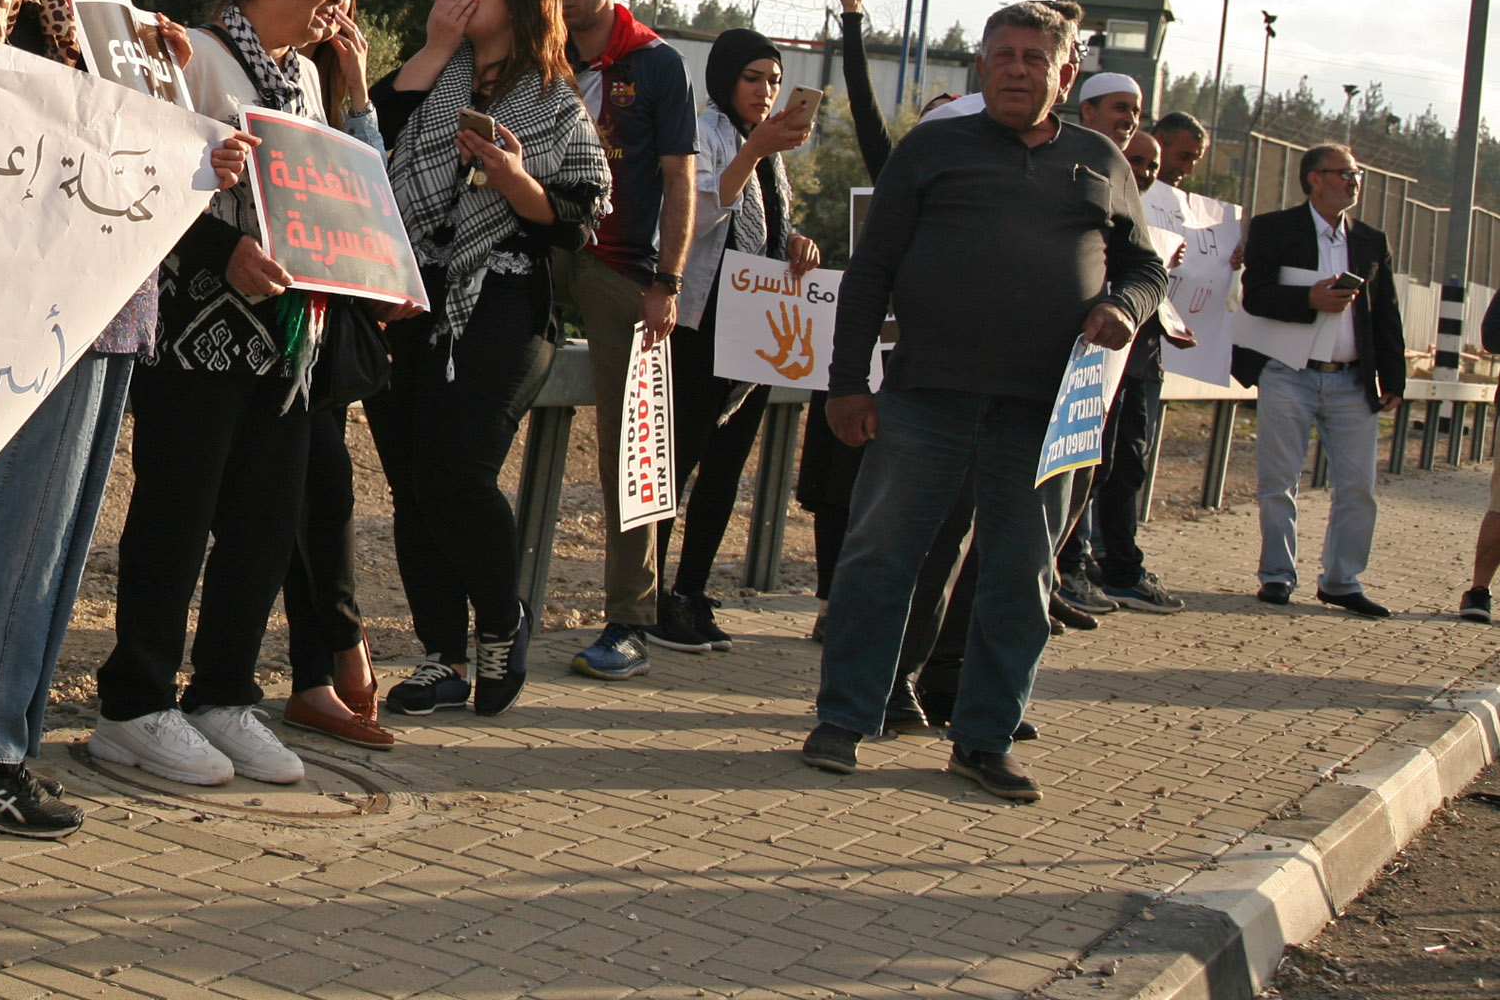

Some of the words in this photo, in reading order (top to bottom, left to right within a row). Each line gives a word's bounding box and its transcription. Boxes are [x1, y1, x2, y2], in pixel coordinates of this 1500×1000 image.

[269, 149, 372, 208] للتغذية
[285, 209, 400, 268] القسرية
[731, 268, 802, 298] الأسرى
[806, 282, 835, 304] مع
[651, 338, 665, 399] גיעות
[637, 357, 654, 504] פלסטינים
[653, 404, 667, 460] זכויות
[657, 466, 669, 507] אדם
